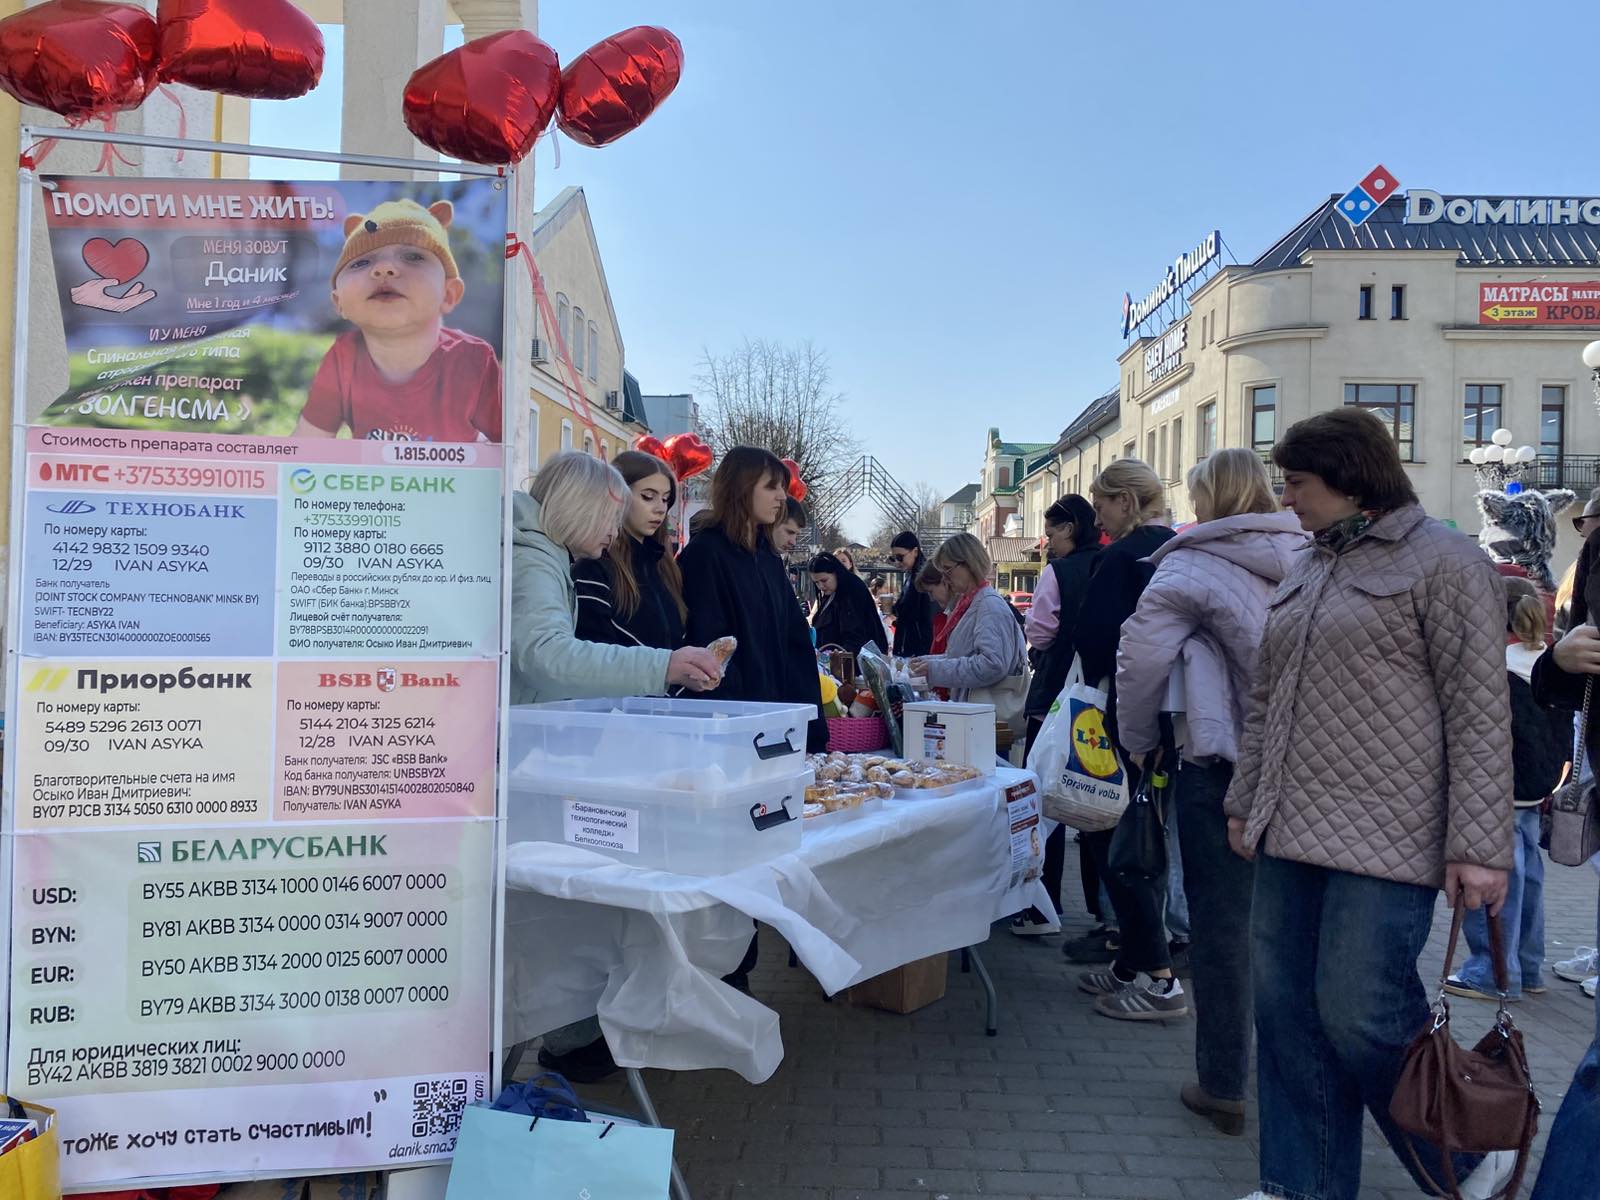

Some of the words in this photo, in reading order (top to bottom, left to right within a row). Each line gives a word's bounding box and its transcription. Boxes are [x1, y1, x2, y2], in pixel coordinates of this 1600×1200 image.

[52, 192, 177, 218] ПОМОГИ
[184, 195, 244, 218] МНЕ
[250, 196, 335, 219] ЖИТЬ!
[204, 240, 242, 254] МЕНЯ
[245, 240, 288, 254] ЗОВУТ
[205, 261, 288, 286] Даник
[1483, 287, 1568, 302] МАТРАСЫ
[186, 298, 212, 309] Мне
[215, 297, 219, 308] 1
[222, 299, 240, 310] год
[1491, 308, 1500, 317] 3
[1503, 307, 1536, 317] этаж
[149, 328, 159, 341] И
[160, 328, 172, 341] У
[173, 326, 207, 339] МЕНЯ
[202, 346, 241, 359] типа
[155, 374, 243, 391] препарат
[42, 433, 127, 450] Стоимость
[130, 439, 213, 454] препарата
[216, 441, 299, 456] составляет
[394, 446, 465, 463] 1.815.000$
[56, 463, 109, 482] МТС
[114, 465, 265, 489] +375339910115
[323, 474, 384, 491] СБЕР
[390, 476, 456, 493] БАНК
[105, 501, 246, 519] ТЕХНОБАНК
[294, 498, 309, 510] По
[311, 501, 351, 512] номеру
[353, 501, 405, 513] телефона:
[303, 513, 401, 527] +375339910115
[44, 523, 60, 535] По
[63, 525, 108, 538] номеру
[110, 525, 148, 538] карты:
[53, 542, 88, 554] 4142
[92, 543, 130, 555] 9832
[135, 544, 167, 556] 1509
[171, 544, 209, 556] 9340
[304, 542, 331, 554] 9112
[335, 543, 370, 554] 3880
[374, 543, 406, 555] 0180
[410, 544, 444, 555] 6665
[53, 558, 93, 572] 12/29
[114, 560, 152, 572] IVAN
[157, 560, 209, 573] ASYKA
[303, 557, 344, 569] 09/30
[358, 558, 392, 569] IVAN
[396, 558, 444, 570] ASYKA
[35, 579, 58, 588] Банк
[60, 579, 110, 590] получатель
[290, 585, 311, 595] ОАО
[312, 585, 337, 595] «Сбер
[339, 586, 363, 595] Банк»
[371, 587, 399, 595] Минск
[68, 607, 114, 617] TECNBY22
[290, 612, 329, 622] Лицевой
[352, 614, 403, 623] получателя:
[289, 639, 311, 648] ФИО
[313, 640, 364, 650] получателя:
[366, 640, 394, 649] Осыко
[396, 640, 418, 649] Иван
[419, 640, 473, 649] Дмитриевич
[77, 667, 252, 694] Приорбанк
[317, 673, 372, 688] BSB
[400, 673, 461, 687] Bank
[45, 721, 86, 734] 5489
[89, 720, 127, 733] 5296
[130, 720, 163, 732] 2613
[167, 719, 201, 732] 0071
[299, 718, 332, 730] 5144
[335, 718, 369, 730] 2104
[371, 717, 401, 729] 3125
[404, 717, 435, 729] 6214
[44, 739, 90, 754] 09/30
[108, 739, 146, 750] IVAN
[150, 737, 203, 750] ASYKA
[299, 735, 335, 748] 12/28
[349, 735, 383, 747] IVAN
[387, 734, 435, 747] ASYKA
[1077, 728, 1111, 750] LID
[34, 774, 156, 788] Благотворительные
[160, 773, 192, 785] счета
[195, 772, 209, 783] на
[212, 772, 235, 783] имя
[284, 770, 302, 781] Код
[304, 769, 332, 780] банка
[334, 769, 391, 781] получателя:
[393, 768, 446, 779] UNBSBY2X
[33, 789, 74, 801] Осыко
[77, 787, 109, 800] Иван
[111, 786, 191, 801] Дмитриевич:
[1061, 774, 1096, 794] Správná
[1098, 788, 1120, 800] volba
[32, 805, 64, 818] BY07
[68, 804, 100, 817] PJCB
[103, 803, 131, 816] 3134
[133, 802, 164, 815] 5050
[166, 801, 193, 815] 6310
[196, 800, 228, 814] 0000
[230, 799, 258, 813] 8933
[283, 800, 341, 813] Получатель:
[343, 799, 367, 810] IVAN
[369, 799, 401, 809] ASYKA
[172, 834, 388, 862] БЕЛАРУСБАНК
[32, 887, 77, 904] USD:
[143, 882, 185, 900] BY55
[188, 880, 238, 898] AKBB
[241, 879, 278, 895] 3134
[281, 877, 318, 894] 1000
[322, 876, 359, 892] 0146
[362, 874, 402, 891] 6007
[405, 873, 447, 889] 0000
[31, 926, 76, 945] BYN:
[142, 920, 181, 938] BY81
[185, 918, 235, 936] AKBB
[239, 916, 275, 933] 3134
[278, 915, 321, 932] 0000
[324, 913, 360, 929] 0314
[364, 912, 403, 929] 9007
[407, 911, 448, 927] 0000
[27, 1047, 65, 1069] Для
[72, 1040, 199, 1062] юридических
[202, 1038, 242, 1054] лиц:
[28, 1066, 73, 1086] BY42
[76, 1062, 128, 1081] AKBB
[131, 1059, 168, 1078] 3819
[171, 1057, 207, 1075] 3821
[211, 1055, 252, 1073] 0002
[256, 1053, 299, 1071] 9000
[302, 1050, 345, 1068] 0000
[389, 1137, 457, 1158] danik.sma3
